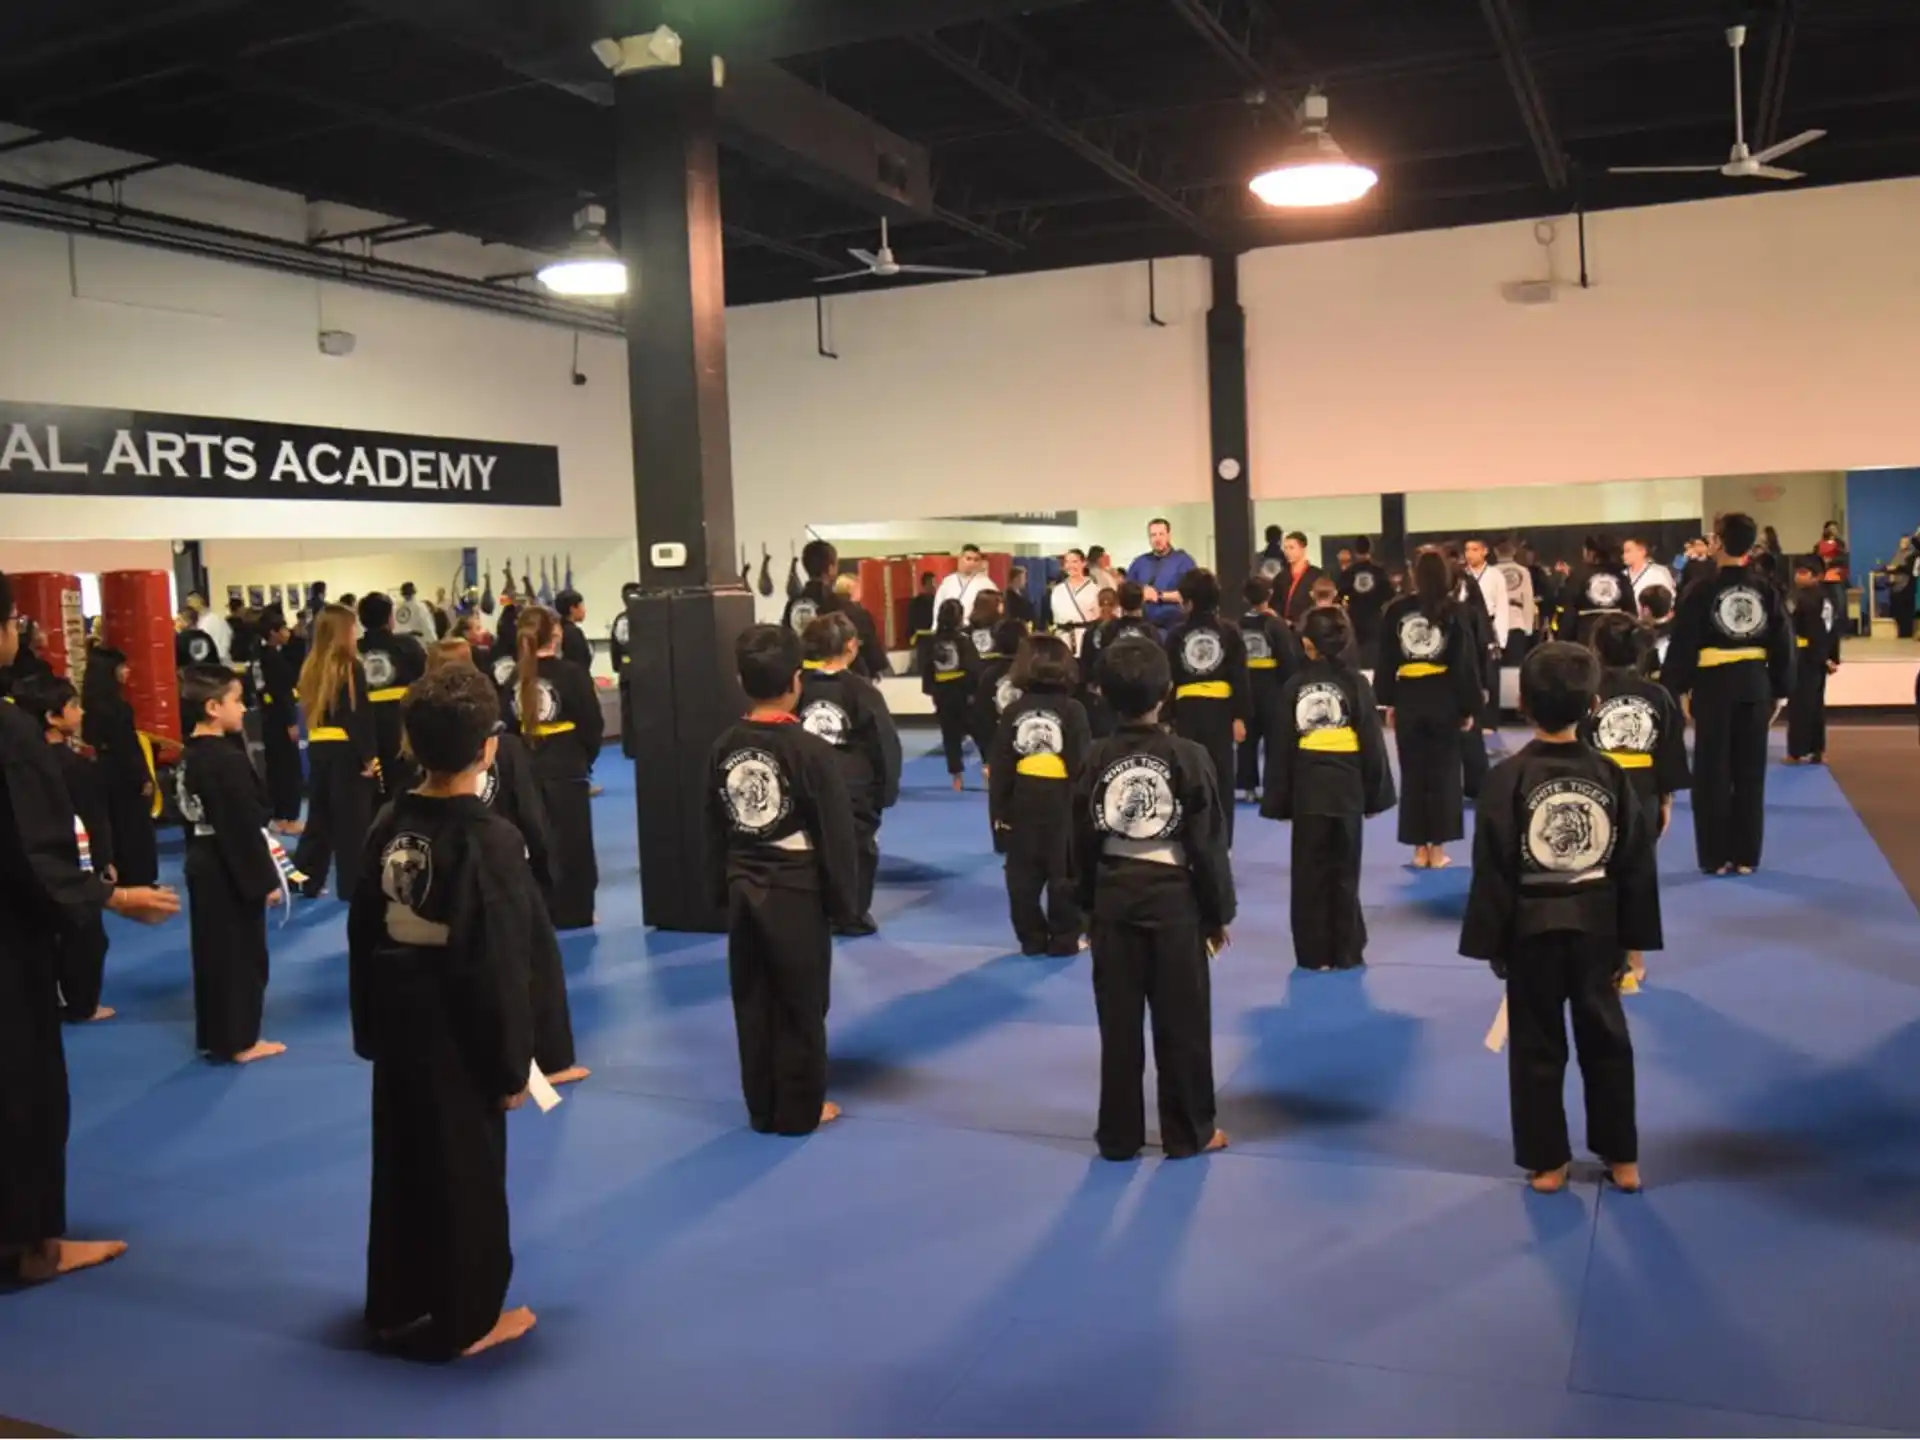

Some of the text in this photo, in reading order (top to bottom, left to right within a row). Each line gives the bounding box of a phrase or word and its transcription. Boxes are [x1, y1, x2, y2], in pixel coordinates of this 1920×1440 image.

[0, 423, 497, 491] AL ARTS ACADEMY
[1103, 758, 1171, 783] WHITE TIGER
[1528, 782, 1611, 810] WHITE TIGER
